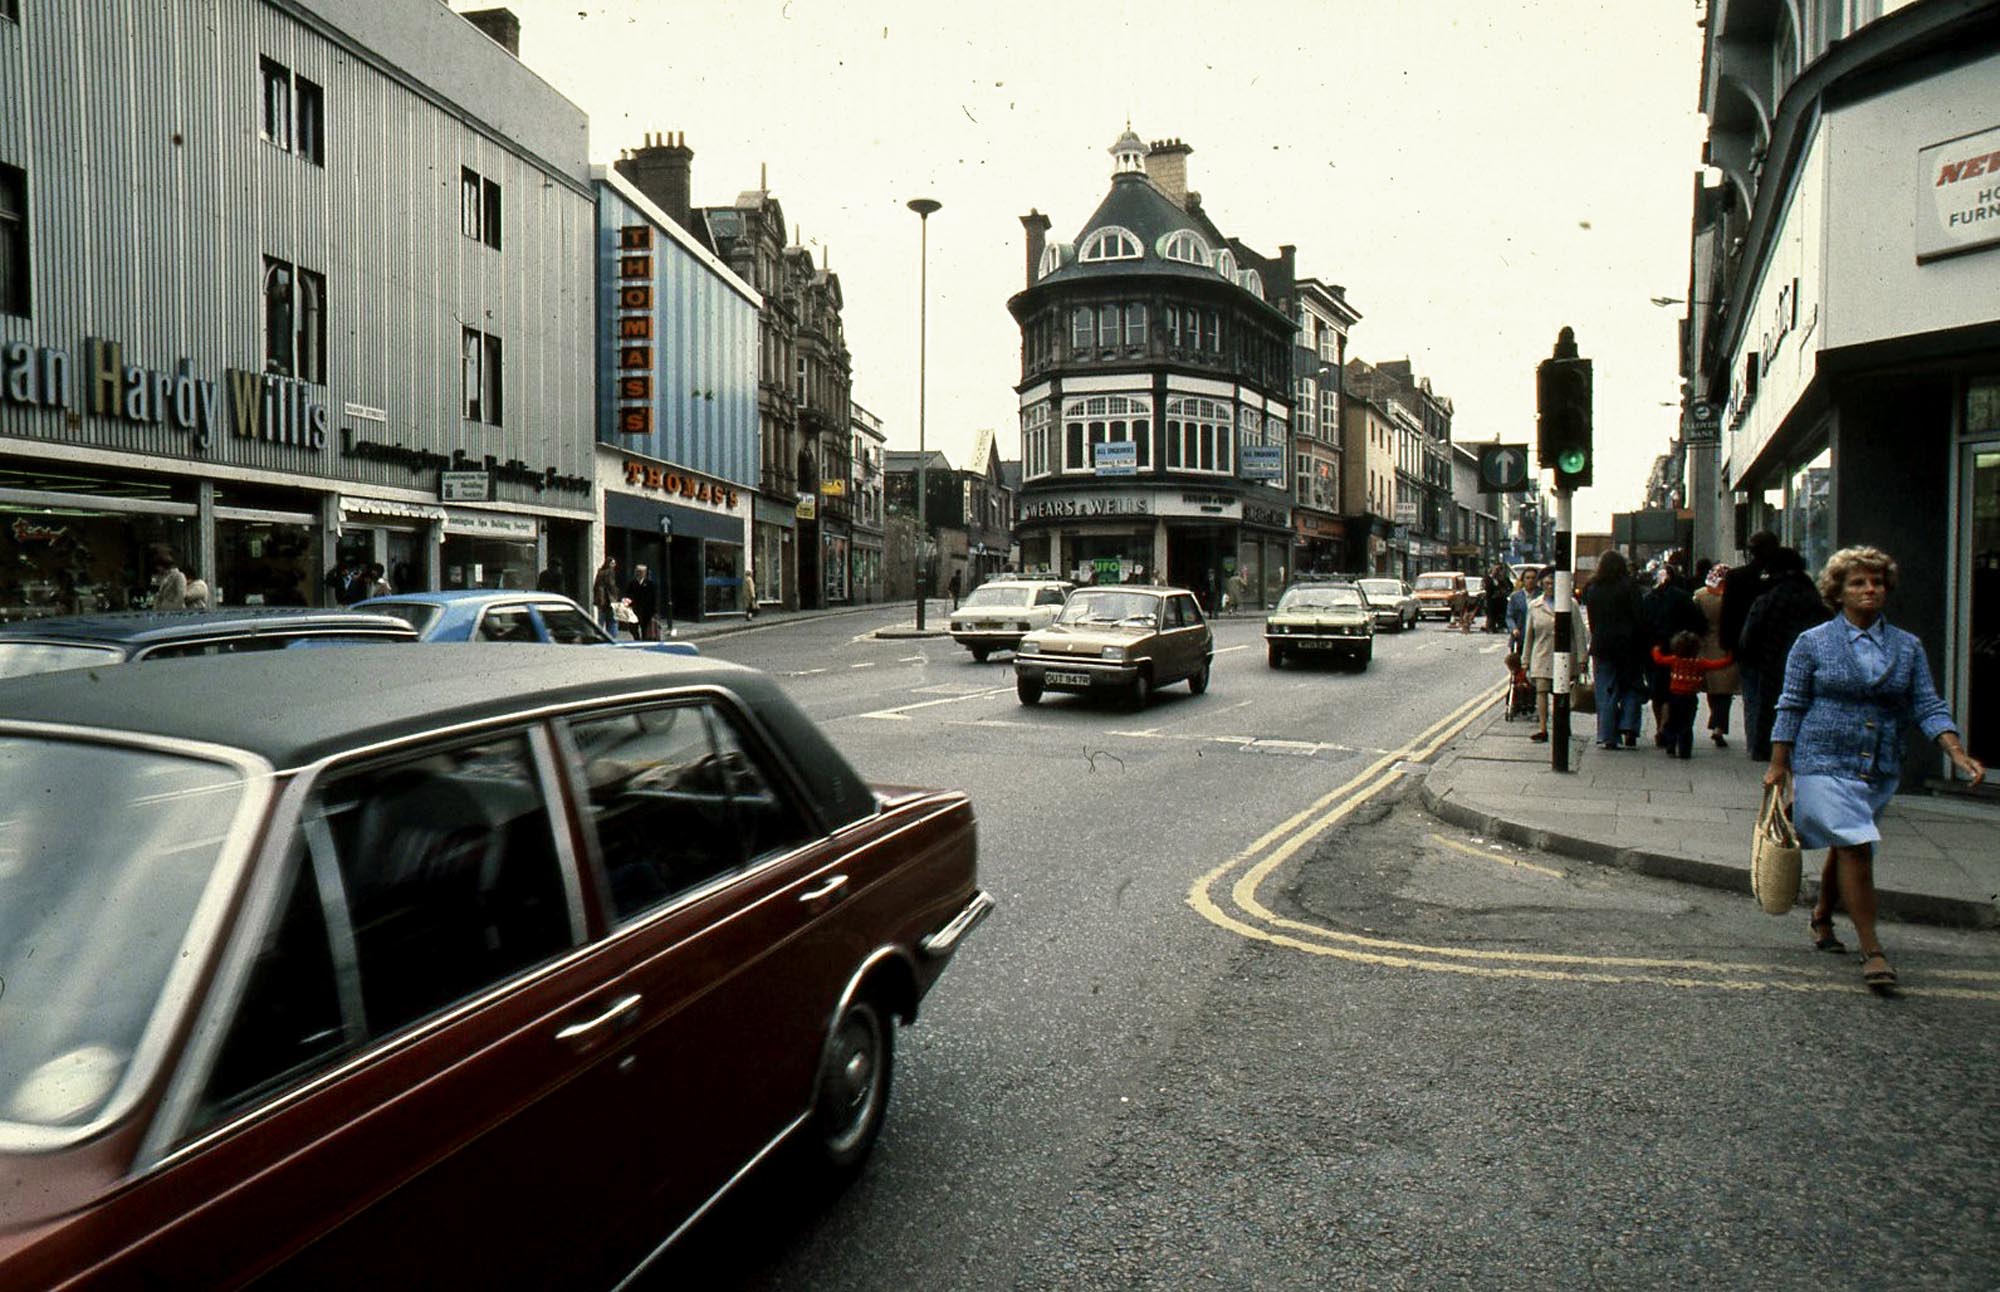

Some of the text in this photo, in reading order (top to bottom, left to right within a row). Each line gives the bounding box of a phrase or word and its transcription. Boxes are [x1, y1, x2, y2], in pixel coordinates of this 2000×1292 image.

[0, 331, 328, 450] an Hardy Willis
[1025, 499, 1075, 518] SWEARS
[1089, 498, 1149, 515] WELLS
[1094, 561, 1119, 572] UFO
